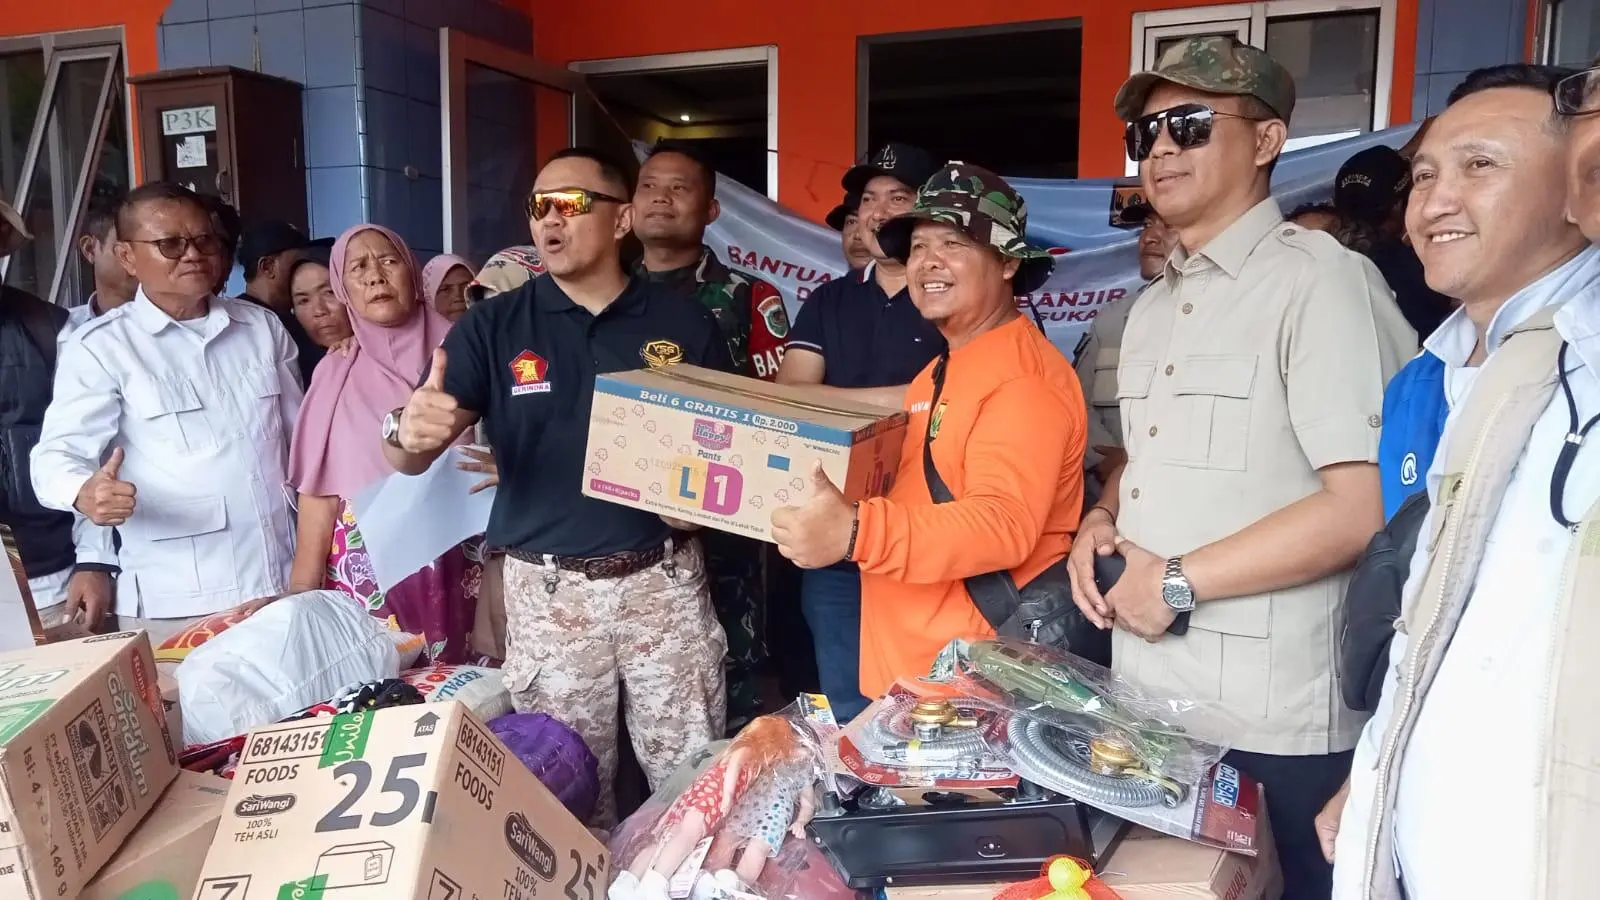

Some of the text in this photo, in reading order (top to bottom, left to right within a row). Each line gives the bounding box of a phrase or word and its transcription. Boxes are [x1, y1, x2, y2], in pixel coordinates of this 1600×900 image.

[165, 109, 214, 131] P3K
[728, 245, 832, 286] BANTUA
[1016, 288, 1127, 308] BANJIR
[640, 390, 796, 431] Beli 6 GRATIS 1 Rp. 2.000
[697, 449, 722, 462] Pants
[679, 466, 697, 500] L
[713, 474, 728, 506] 1
[433, 669, 482, 702] KEPAL
[107, 672, 150, 797] Gandum
[119, 689, 152, 755] Sari
[417, 725, 435, 734] ATAS
[252, 729, 331, 757] 68143151
[460, 723, 503, 777] 68143151
[245, 764, 299, 785] FOODS
[455, 762, 494, 811] FOODS
[1216, 765, 1236, 808] CAISAR
[240, 796, 290, 814] SariWangi
[314, 753, 428, 833] 25
[234, 829, 278, 843] TEH ASLI
[246, 818, 272, 830] 100%
[510, 822, 554, 873] SariWangi
[515, 866, 537, 897] 100%
